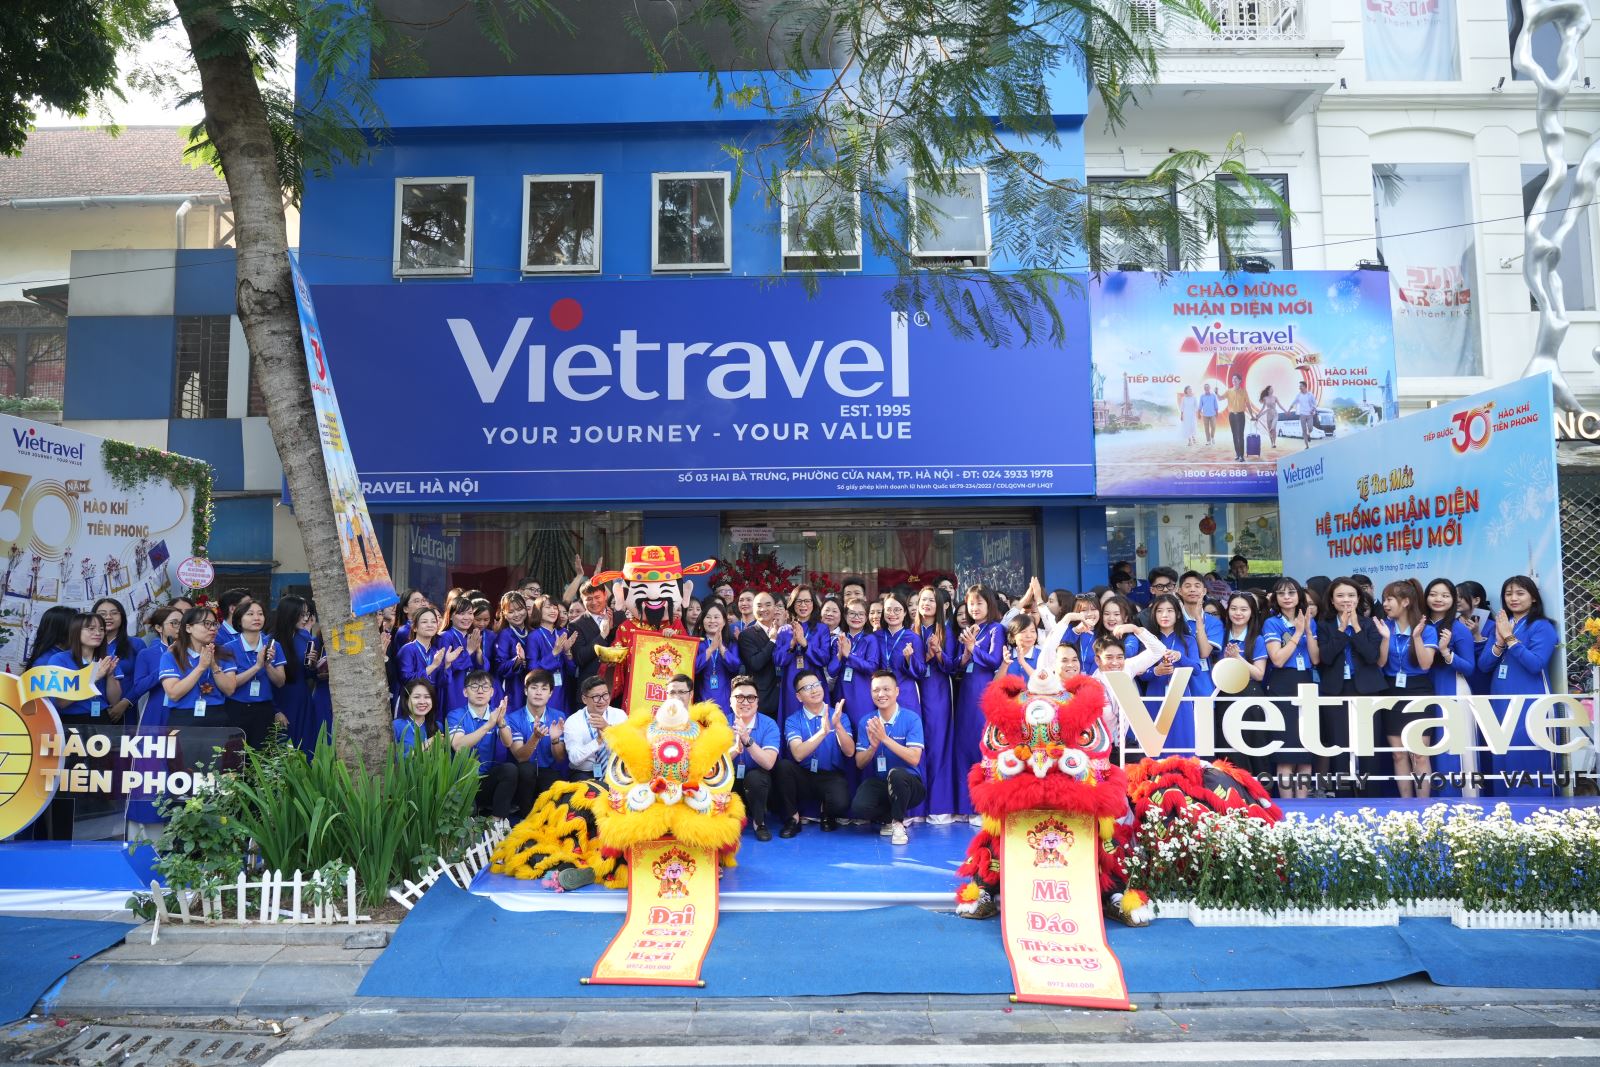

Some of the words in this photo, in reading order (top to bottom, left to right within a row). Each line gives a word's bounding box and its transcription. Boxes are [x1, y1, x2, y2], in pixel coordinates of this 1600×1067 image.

[1187, 281, 1239, 297] CHÀO
[1243, 281, 1298, 297] MỪNG
[1173, 300, 1226, 319] NHẬN
[1230, 299, 1274, 318] DIỆN
[1278, 299, 1313, 315] MỚI
[1191, 322, 1293, 345] Vietravel
[446, 297, 910, 404] Vietravel
[1127, 372, 1150, 384] TIẾP
[1152, 372, 1181, 383] BƯỚC
[1318, 376, 1342, 387] TIÊN
[1343, 377, 1378, 386] PHONG
[1324, 366, 1347, 376] HÀO
[1349, 366, 1368, 376] KHÍ
[840, 404, 872, 417] EST.
[875, 404, 911, 417] 1995
[1497, 407, 1515, 420] HÀO
[1516, 400, 1531, 415] KHÍ
[482, 426, 558, 445] YOUR
[569, 424, 701, 444] JOURNEY
[733, 423, 809, 441] YOUR
[821, 421, 912, 440] VALUE
[1452, 407, 1492, 454] 30
[1492, 421, 1509, 433] TIÊN
[1510, 413, 1539, 428] PHONG
[13, 427, 83, 461] Vietravel
[1423, 430, 1436, 442] TIẾP
[1436, 427, 1454, 439] BƯỚC
[678, 470, 693, 482] SỐ
[695, 473, 708, 482] 03
[711, 472, 730, 482] HAI
[732, 470, 747, 481] BÀ
[750, 470, 789, 482] TRƯNG,
[792, 469, 839, 481] PHƯỜNG
[841, 469, 864, 480] CỬA
[867, 471, 894, 481] NAM,
[897, 470, 913, 480] TP.
[915, 468, 931, 480] HÀ
[934, 468, 953, 481] NỘI
[962, 470, 980, 479] ĐT:
[982, 469, 1001, 479] 024
[1003, 469, 1028, 479] 3933
[1030, 469, 1054, 479] 1978
[1183, 470, 1206, 478] 1800
[1208, 469, 1227, 478] 646
[1229, 469, 1248, 477] 888
[1256, 469, 1278, 477] trav
[1283, 456, 1324, 484] Vietravel
[360, 480, 415, 494] RAVEL
[420, 477, 444, 494] HÀ
[449, 477, 479, 496] NỘI
[1371, 473, 1388, 495] Ra
[83, 498, 108, 514] HÀO
[110, 499, 129, 516] KHÍ
[1315, 511, 1332, 539] HỆ
[1334, 503, 1381, 534] THỐNG
[1384, 495, 1431, 527] NHẬN
[1434, 485, 1480, 520] DIỆN
[87, 520, 111, 536] TIÊN
[113, 525, 150, 538] PHONG
[1327, 532, 1383, 559] THƯƠNG
[1386, 524, 1424, 556] HIỆU
[1427, 517, 1463, 549] MỚI
[331, 621, 367, 656] 15
[30, 670, 81, 692] NĂM
[39, 727, 111, 758] HÀO
[119, 729, 181, 759] KHÍ
[39, 763, 112, 793] TIÊN
[1411, 771, 1485, 790] YOUR
[1500, 770, 1588, 789] VALUE
[1032, 879, 1071, 903] Mã
[1027, 911, 1078, 935] Đáo
